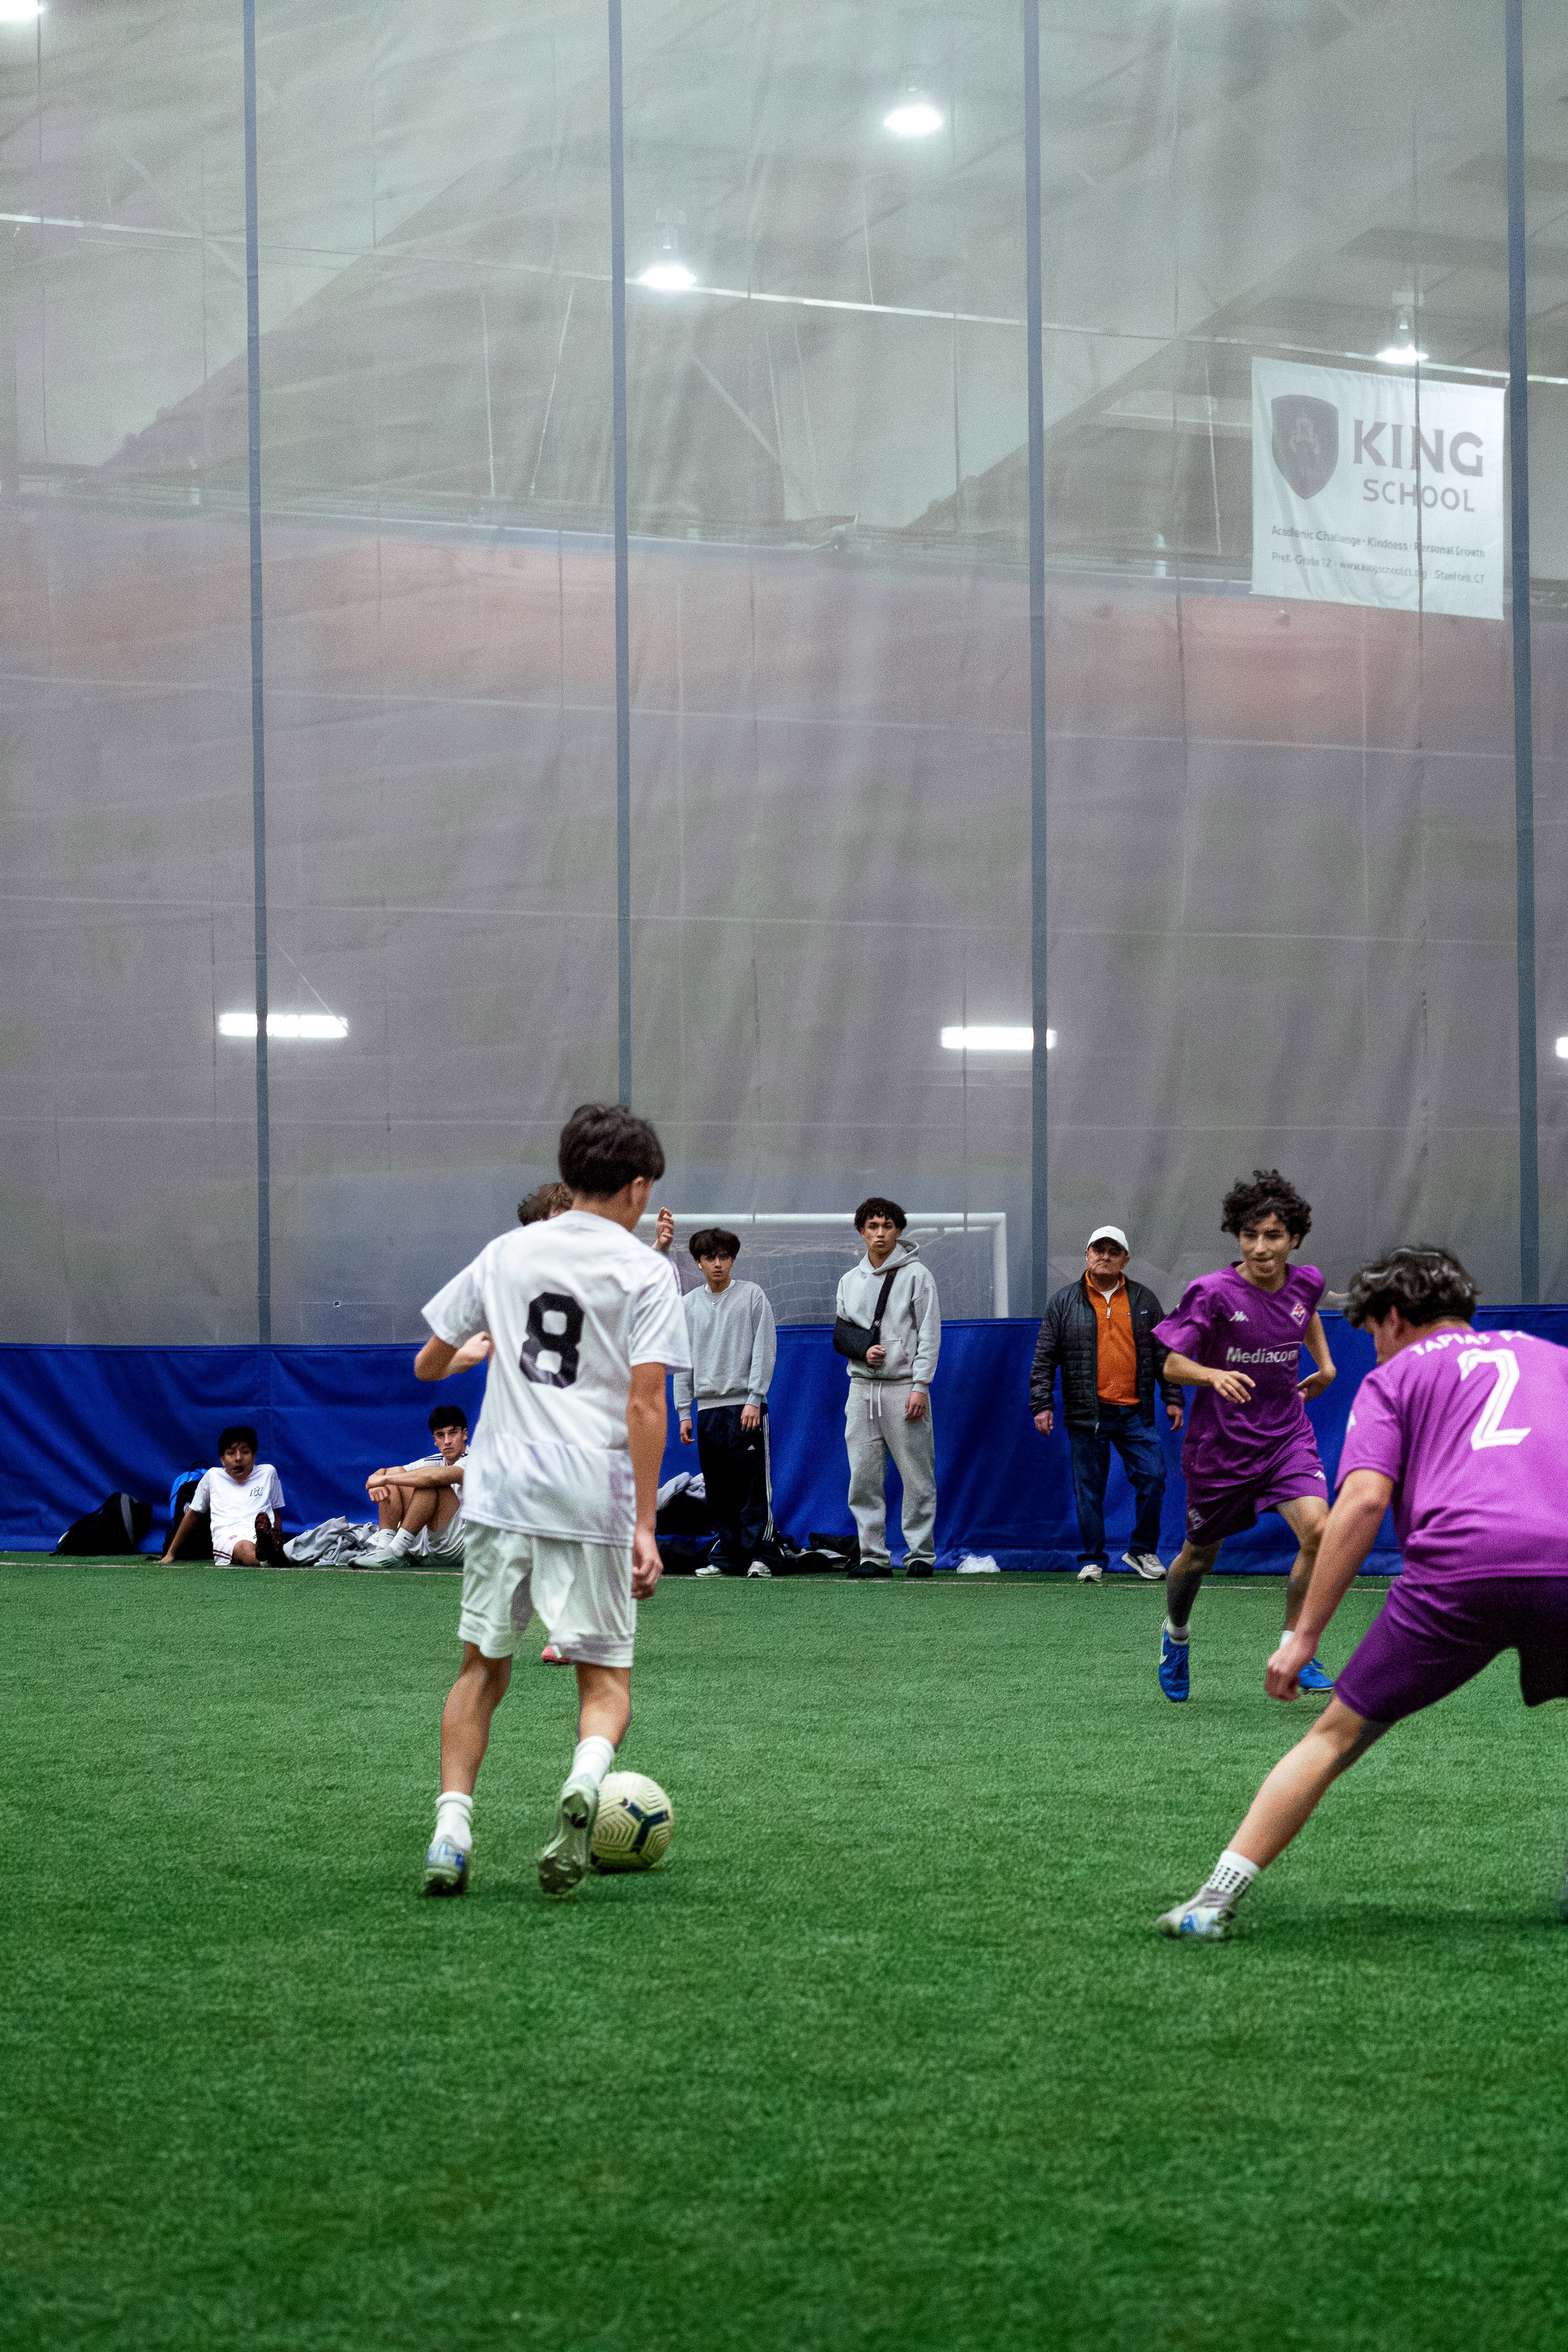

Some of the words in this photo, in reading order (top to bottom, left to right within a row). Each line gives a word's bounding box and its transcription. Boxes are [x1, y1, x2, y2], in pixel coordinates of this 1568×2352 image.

[1352, 419, 1483, 477] KING
[1363, 478, 1475, 513] SCHOOL
[1367, 537, 1408, 551] Kindness
[1455, 546, 1485, 559] Growth
[519, 1292, 584, 1389] 8
[1457, 1348, 1531, 1450] 2
